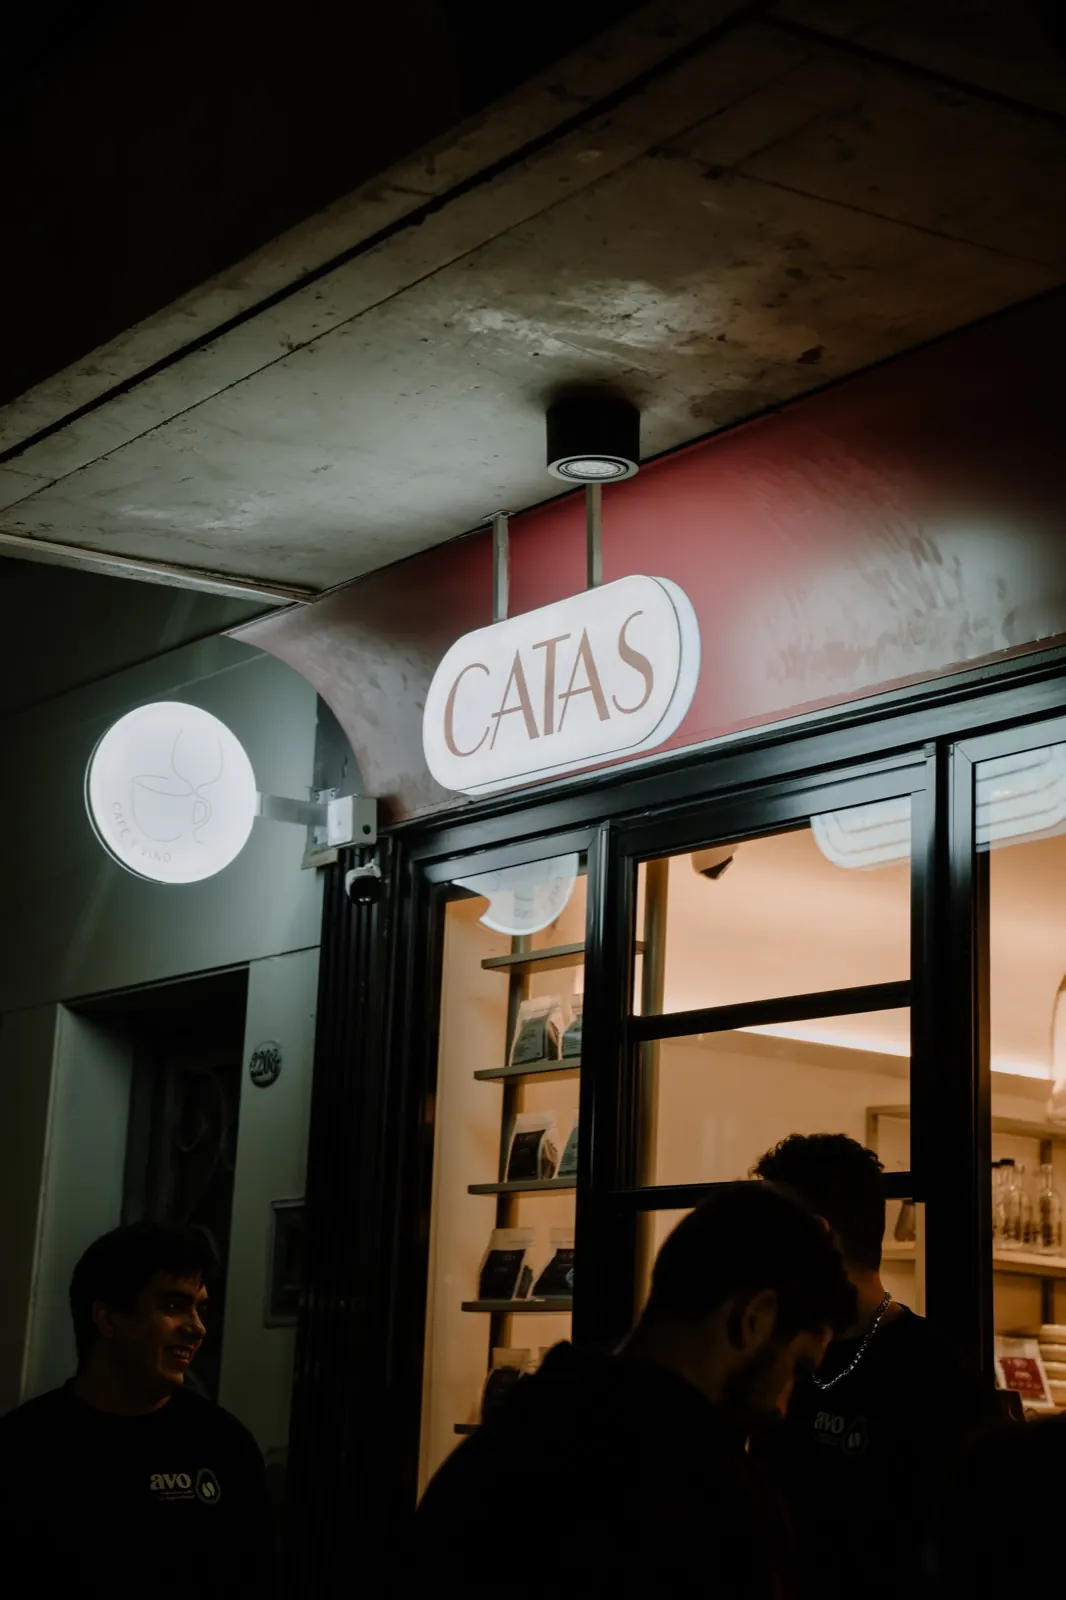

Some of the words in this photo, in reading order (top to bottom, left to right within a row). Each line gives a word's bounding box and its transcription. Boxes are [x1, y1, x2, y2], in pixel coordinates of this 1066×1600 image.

[443, 610, 654, 758] CATAS
[141, 845, 172, 864] VINO
[814, 1410, 845, 1434] avo
[149, 1472, 192, 1491] avo
